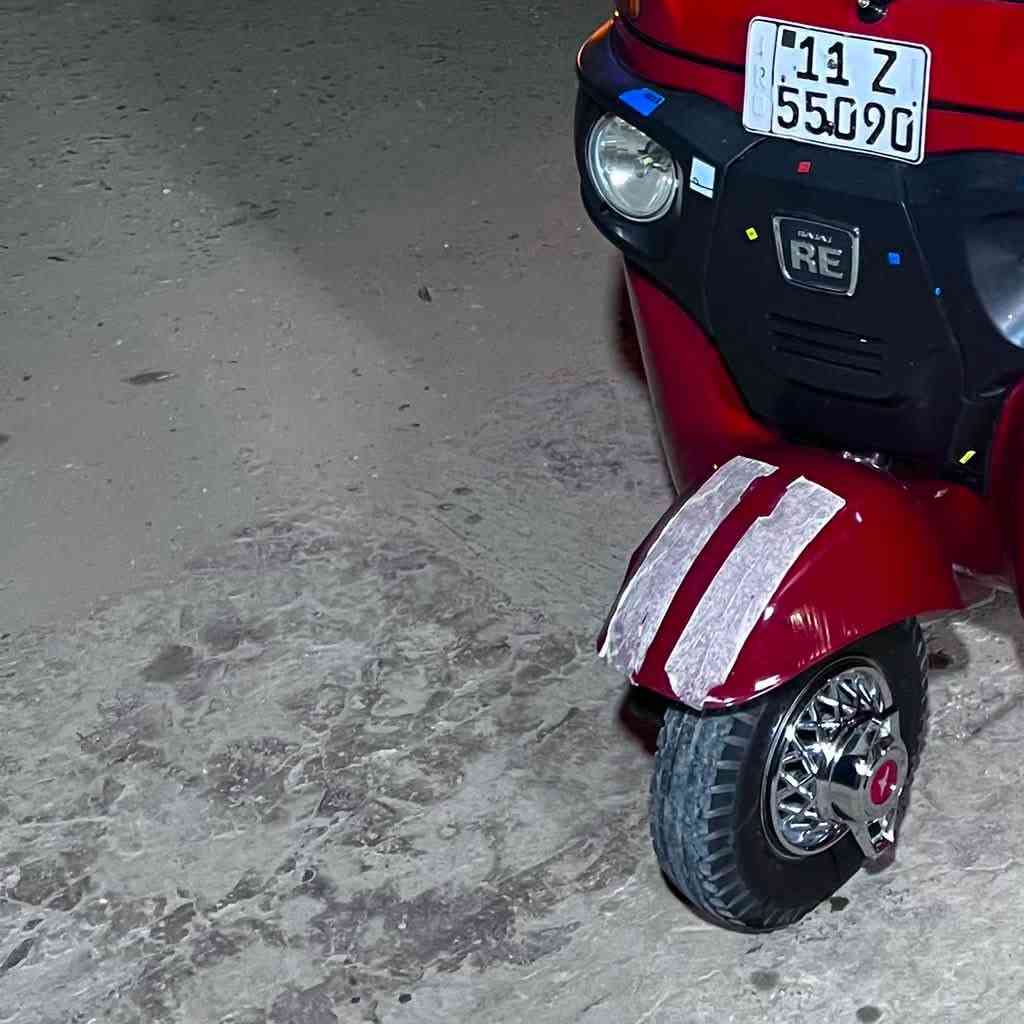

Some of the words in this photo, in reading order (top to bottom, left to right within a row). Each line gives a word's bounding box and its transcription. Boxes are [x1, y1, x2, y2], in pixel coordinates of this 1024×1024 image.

[796, 36, 849, 86] 11
[872, 48, 897, 95] Z
[777, 85, 914, 153] 55090
[790, 240, 843, 279] RE
